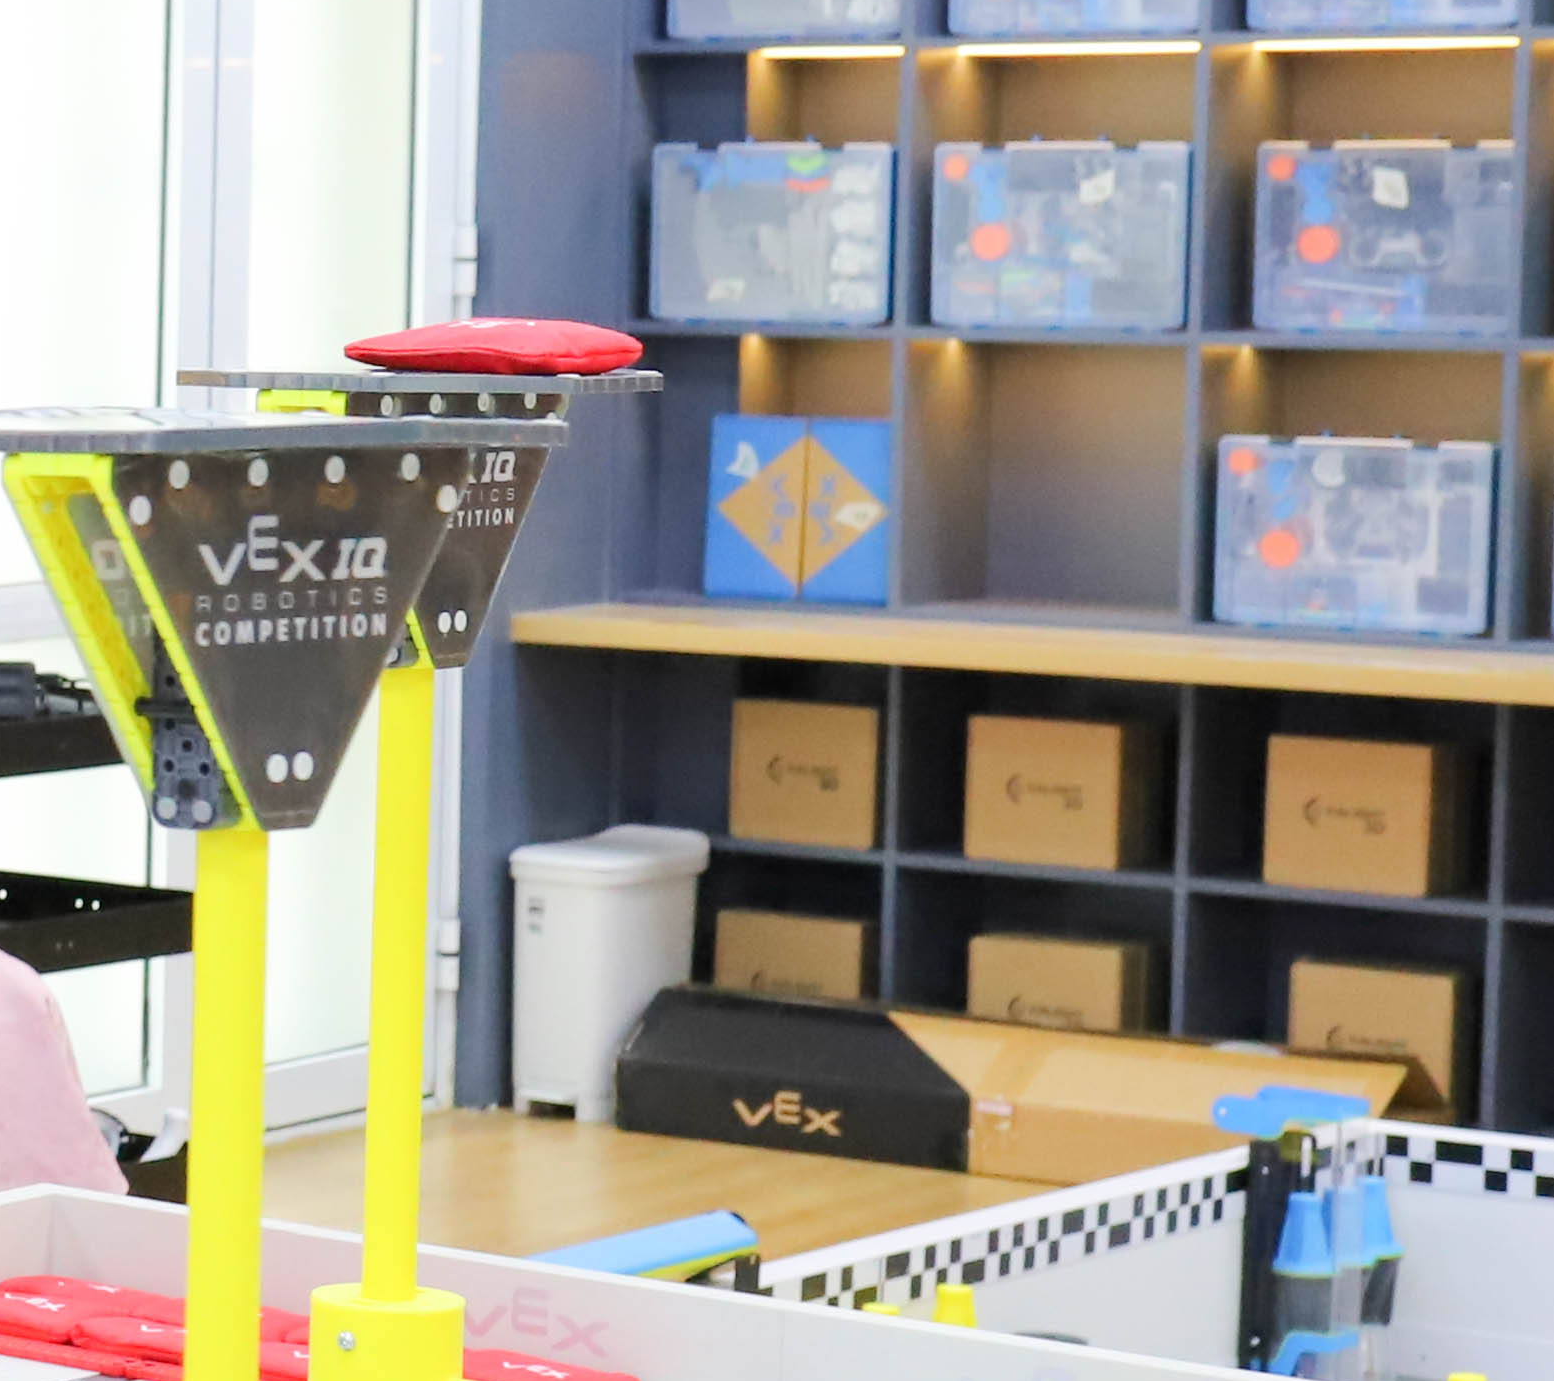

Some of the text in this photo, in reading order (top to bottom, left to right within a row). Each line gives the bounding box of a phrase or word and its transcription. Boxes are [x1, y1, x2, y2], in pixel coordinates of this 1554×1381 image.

[481, 450, 517, 484] IQ
[464, 487, 516, 502] TICS
[447, 507, 515, 530] TITION
[197, 514, 327, 587] VEX
[331, 536, 388, 580] IQ
[195, 586, 388, 612] ROBOTICS
[194, 613, 388, 647] COMPETITION
[731, 1089, 842, 1137] VEX
[466, 1285, 609, 1359] VEX
[501, 1360, 569, 1380] VEX
